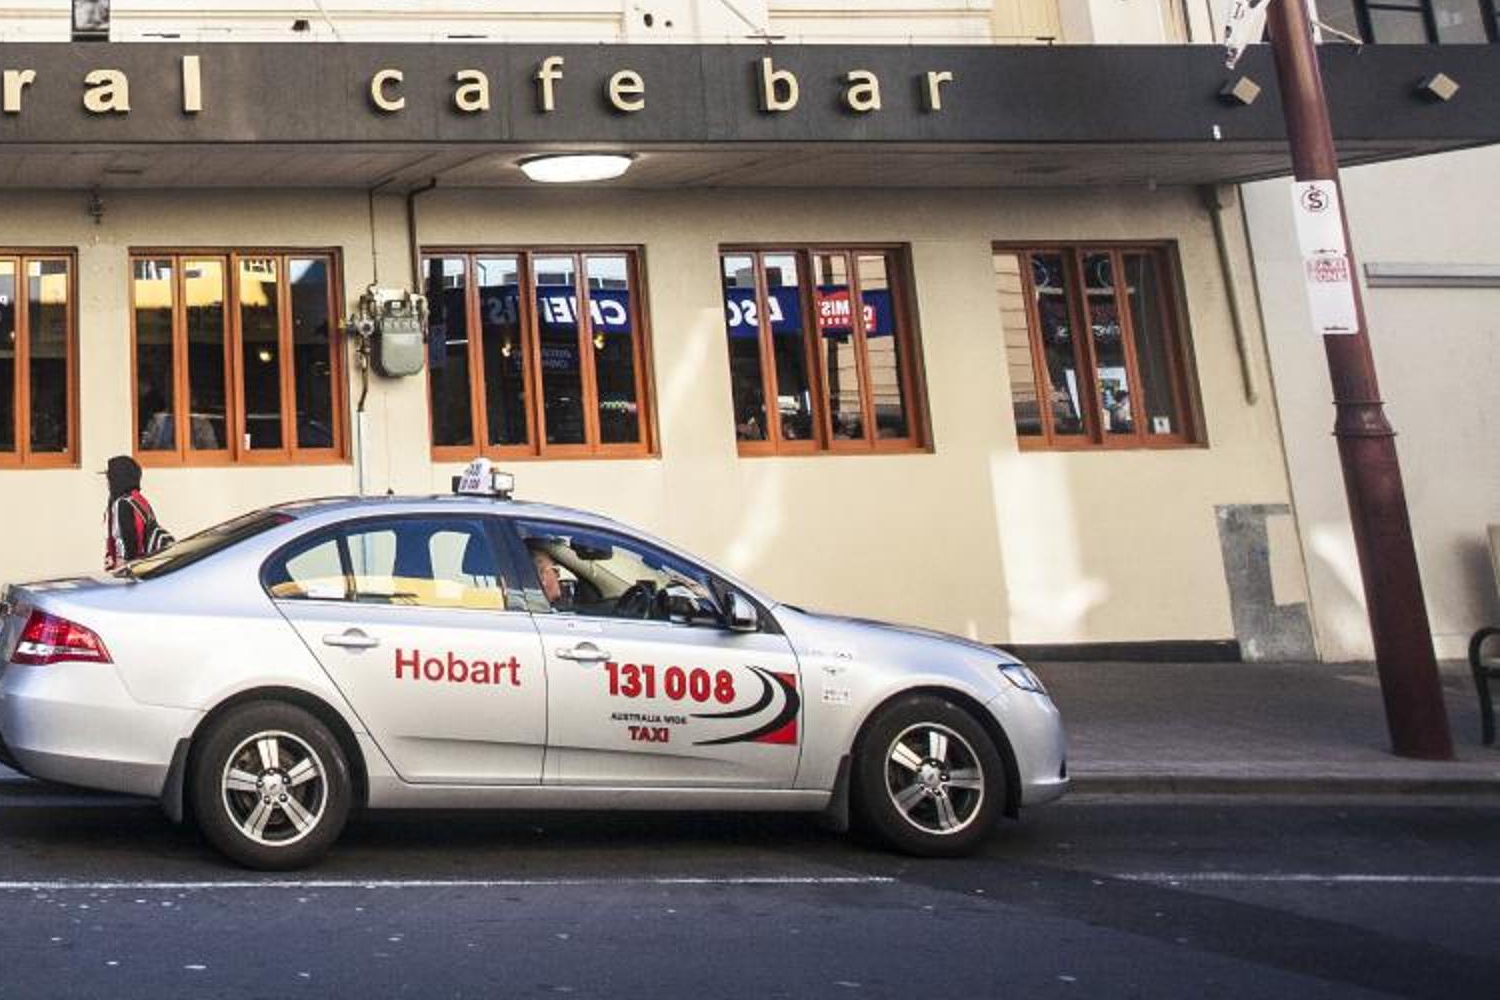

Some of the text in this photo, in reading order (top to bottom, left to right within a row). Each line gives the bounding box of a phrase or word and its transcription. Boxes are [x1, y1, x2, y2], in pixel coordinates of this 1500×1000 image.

[370, 56, 646, 112] cafe
[760, 57, 953, 112] bar
[395, 647, 521, 686] Hobart
[604, 661, 736, 705] 131 008
[611, 712, 687, 725] AUSTRALIA WIDE
[628, 725, 669, 743] TAXI
